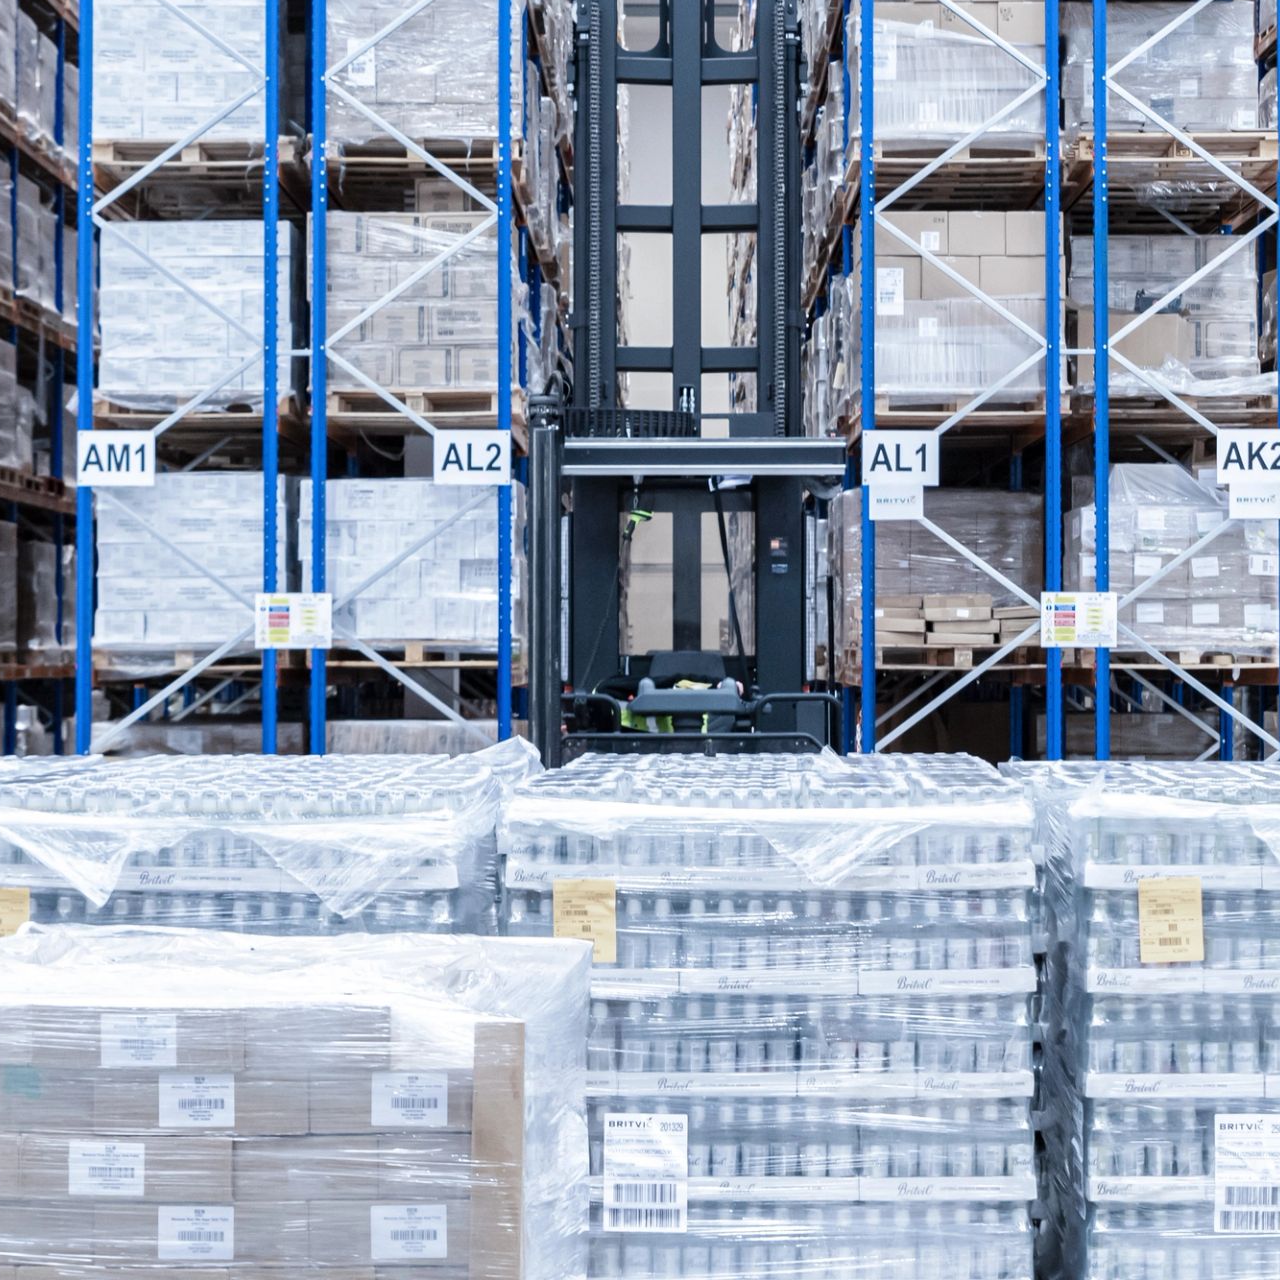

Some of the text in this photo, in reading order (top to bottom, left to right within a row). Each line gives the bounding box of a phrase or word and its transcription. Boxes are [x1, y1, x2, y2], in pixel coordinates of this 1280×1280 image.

[82, 443, 149, 471] AM1
[441, 441, 501, 472] AL2
[870, 443, 926, 472] AL1
[138, 869, 177, 886] Britvic
[926, 870, 962, 886] Britvic
[718, 975, 755, 992] Britvic
[896, 975, 934, 991] Britvic
[1243, 973, 1280, 990] Britvic
[657, 1077, 695, 1093] Britvic
[923, 1077, 960, 1092] Britvic
[1124, 1078, 1162, 1095] Britvic
[608, 1116, 684, 1132] BRITVIC 201329
[1219, 1121, 1263, 1133] BRITVIC
[898, 1181, 935, 1197] Britvic
